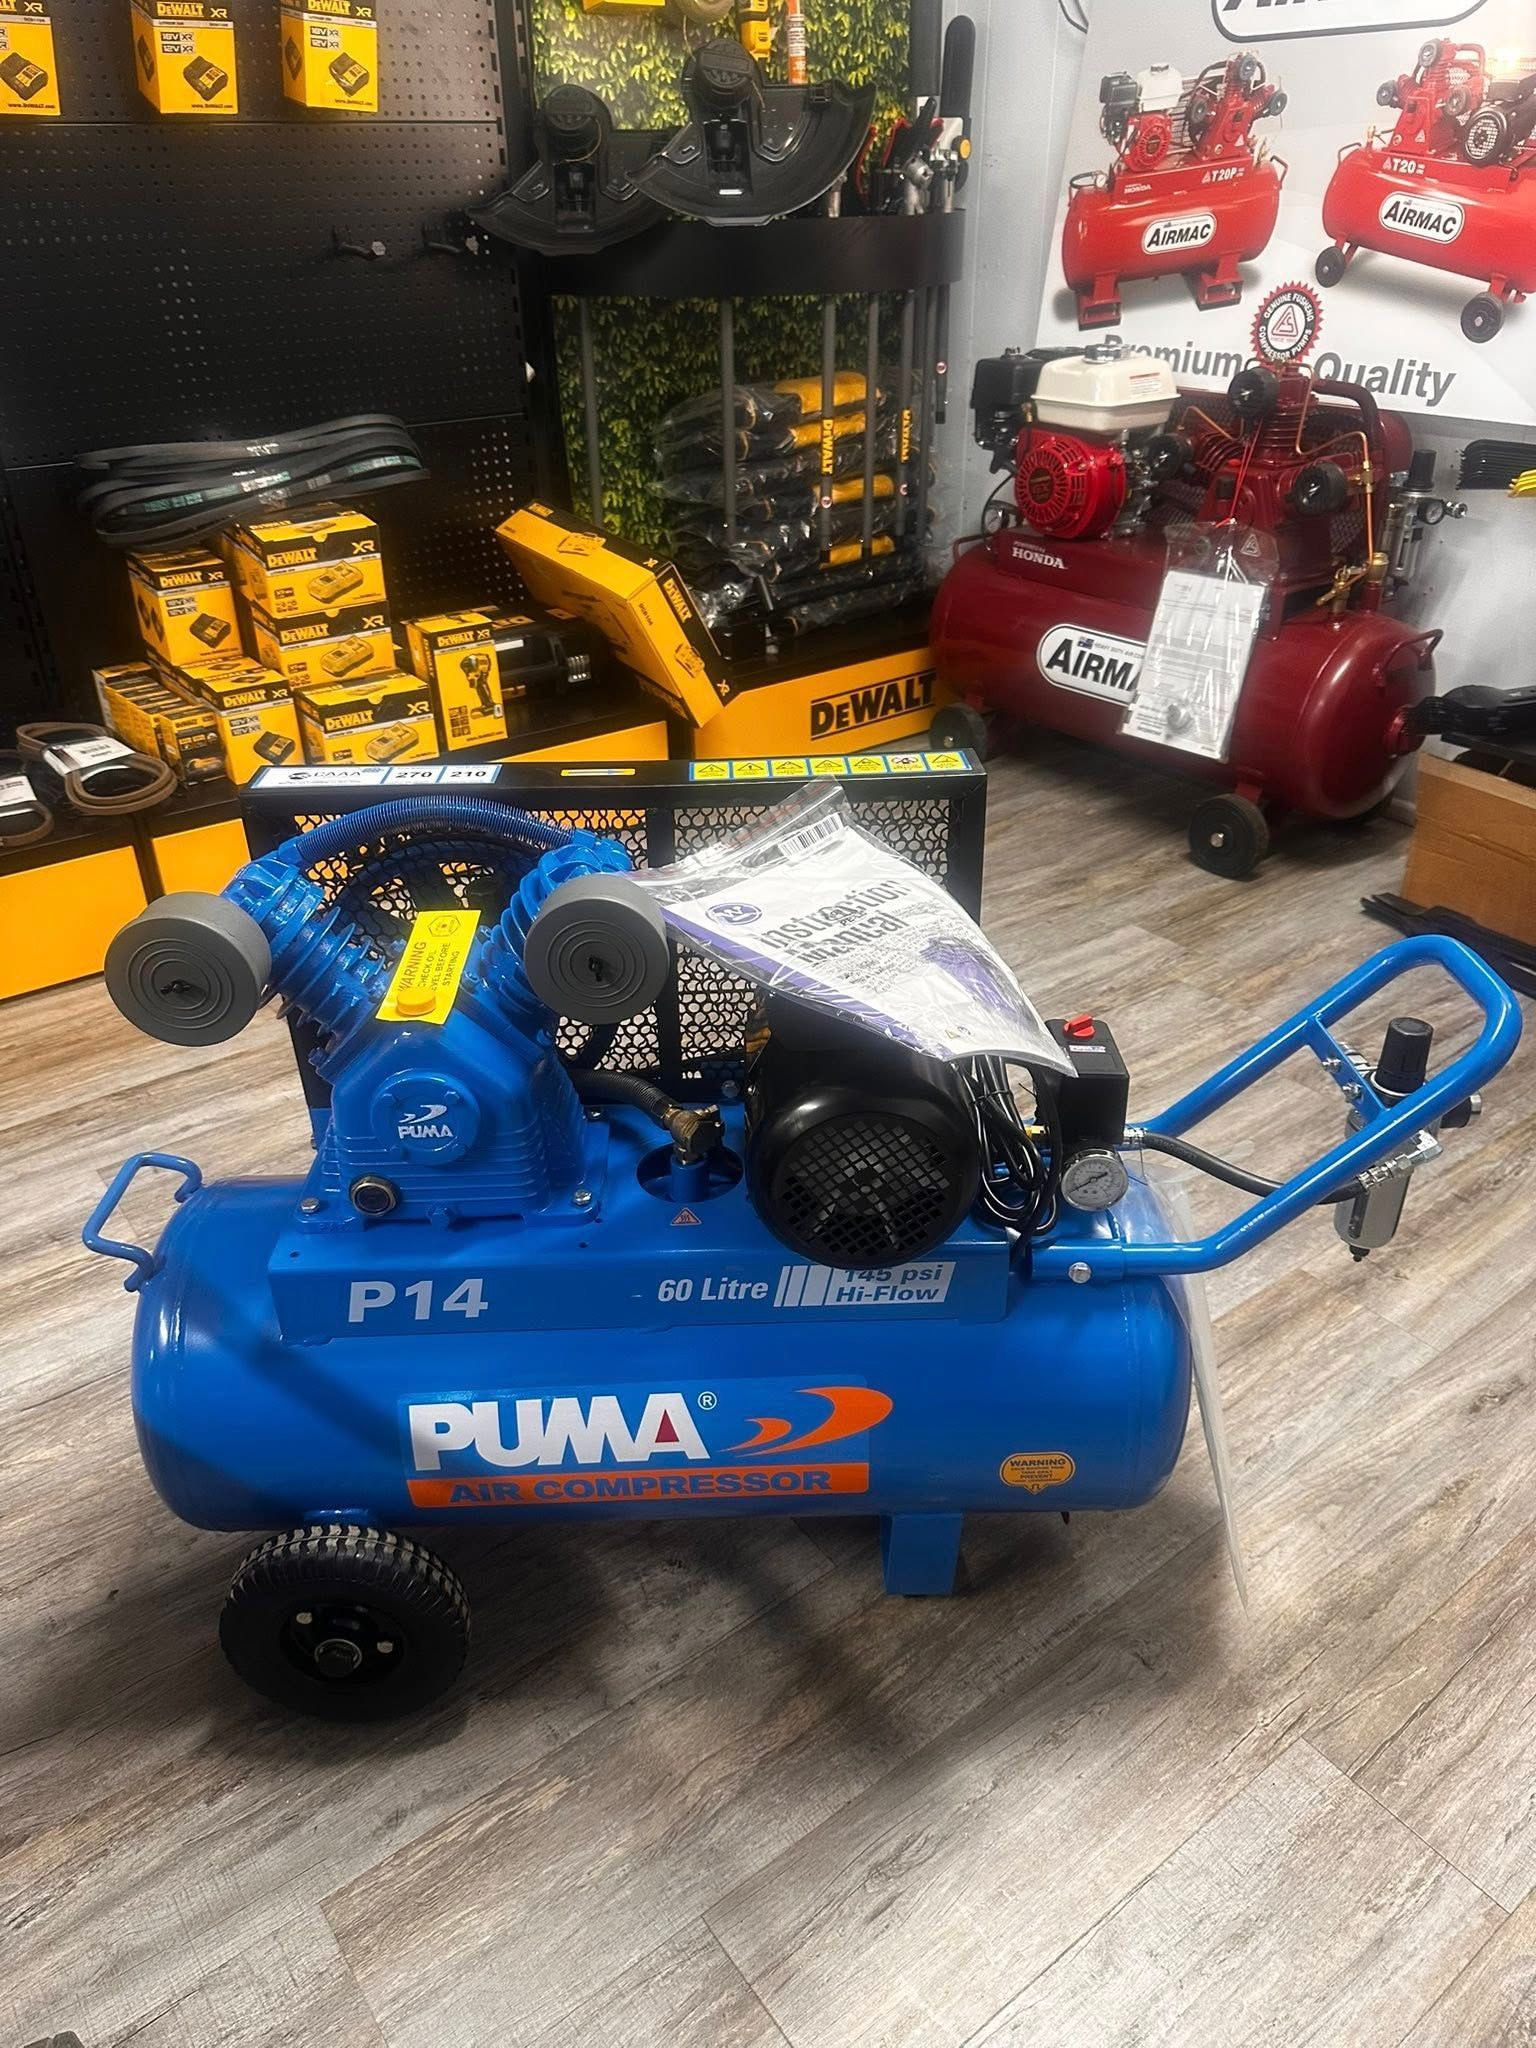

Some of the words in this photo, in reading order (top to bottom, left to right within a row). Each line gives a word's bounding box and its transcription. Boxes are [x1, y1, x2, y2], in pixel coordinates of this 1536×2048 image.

[24, 2, 43, 13] XR
[157, 2, 204, 17] DEWALT
[211, 8, 227, 18] XR
[307, 0, 351, 15] DEWALT
[356, 6, 372, 17] XR
[1384, 200, 1457, 235] AIRMAC
[1147, 223, 1212, 248] AIRMAC
[1104, 334, 1242, 377] mium
[1312, 351, 1456, 407] Quality
[821, 418, 834, 475] DEWALT
[267, 548, 317, 568] DEWALT
[352, 540, 375, 554] XR
[1012, 547, 1066, 569] HONDA
[160, 571, 202, 588] DEWALT
[208, 571, 224, 581] XR
[281, 623, 329, 643] DEWALT
[362, 615, 385, 629] XR
[437, 630, 474, 647] DEWALT
[477, 629, 491, 640] XR
[1045, 638, 1141, 692] AIRM
[223, 689, 266, 707] DEWALT
[272, 689, 288, 699] XR
[811, 670, 937, 737] DEWALT
[325, 710, 374, 731] DEWALT
[407, 701, 429, 715] XR
[395, 771, 433, 779] 270
[398, 1125, 454, 1139] PUMA
[900, 1264, 943, 1285] psi
[348, 1278, 489, 1323] P14
[658, 1278, 693, 1302] 60
[700, 1277, 769, 1301] Litre
[835, 1285, 939, 1303] Hi-Flow
[409, 1392, 711, 1471] PUMA
[1009, 1459, 1066, 1467] WARNING
[450, 1482, 522, 1503] AIR
[534, 1470, 833, 1499] COMPRESSOR
